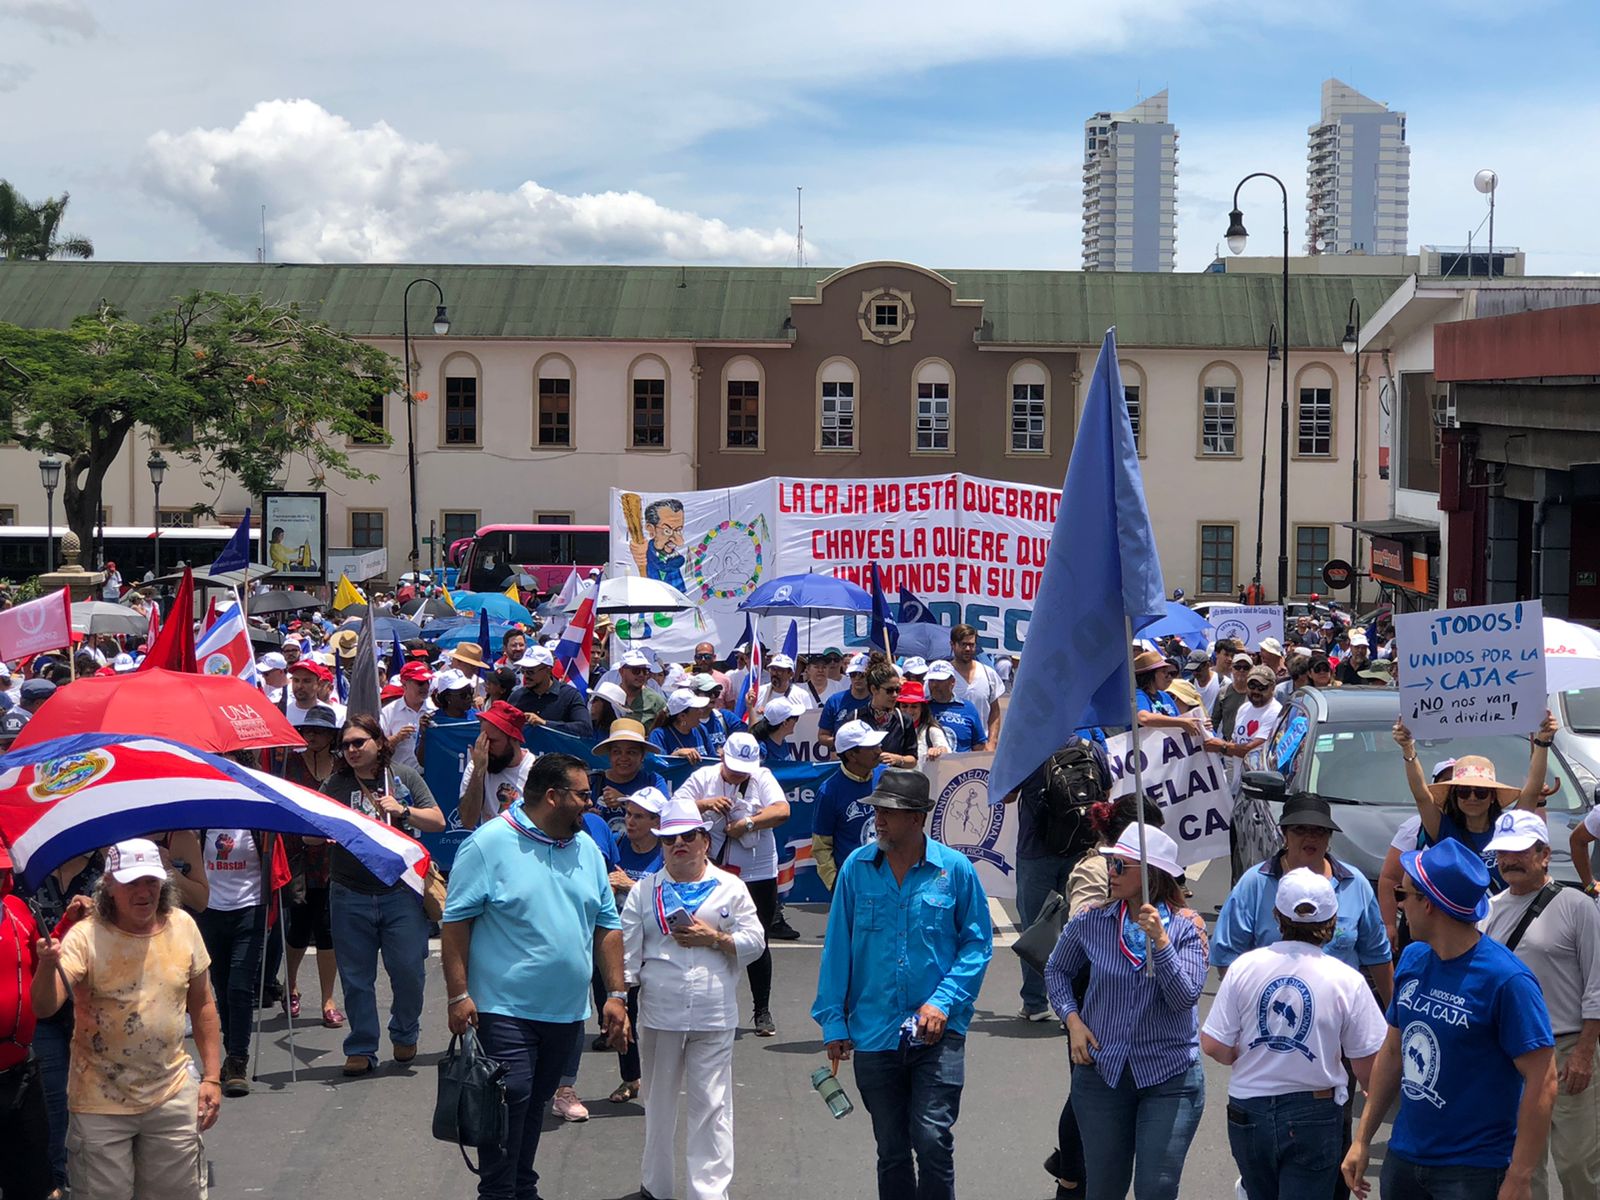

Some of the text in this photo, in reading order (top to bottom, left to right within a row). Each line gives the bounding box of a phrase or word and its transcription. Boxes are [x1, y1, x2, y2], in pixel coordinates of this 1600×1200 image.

[779, 483, 805, 513] LA
[811, 484, 867, 514] CAJA
[873, 483, 900, 513] NO
[905, 474, 957, 513] ESTÁ
[812, 529, 895, 560] CHAVES
[900, 527, 927, 558] LA
[1017, 535, 1051, 567] QU
[955, 563, 981, 595] EN
[987, 567, 1015, 598] SU
[1430, 603, 1523, 645] ¡TODOS!
[1409, 648, 1538, 668] UNIDOS POR LA
[1440, 667, 1501, 690] CAJA
[219, 703, 261, 721] UNA
[1412, 693, 1511, 719] ¡NO nos van
[1439, 715, 1448, 724] a
[1111, 732, 1203, 780] NO AL
[935, 782, 957, 816] UNION
[1179, 808, 1231, 841] CA
[217, 860, 247, 871] Basta!
[966, 848, 985, 857] RICA
[1276, 978, 1305, 994] MEDICA
[1299, 994, 1312, 1037] NACIONAL
[1412, 997, 1470, 1029] LA CAJA
[1430, 988, 1466, 1007] UNIDOS POR
